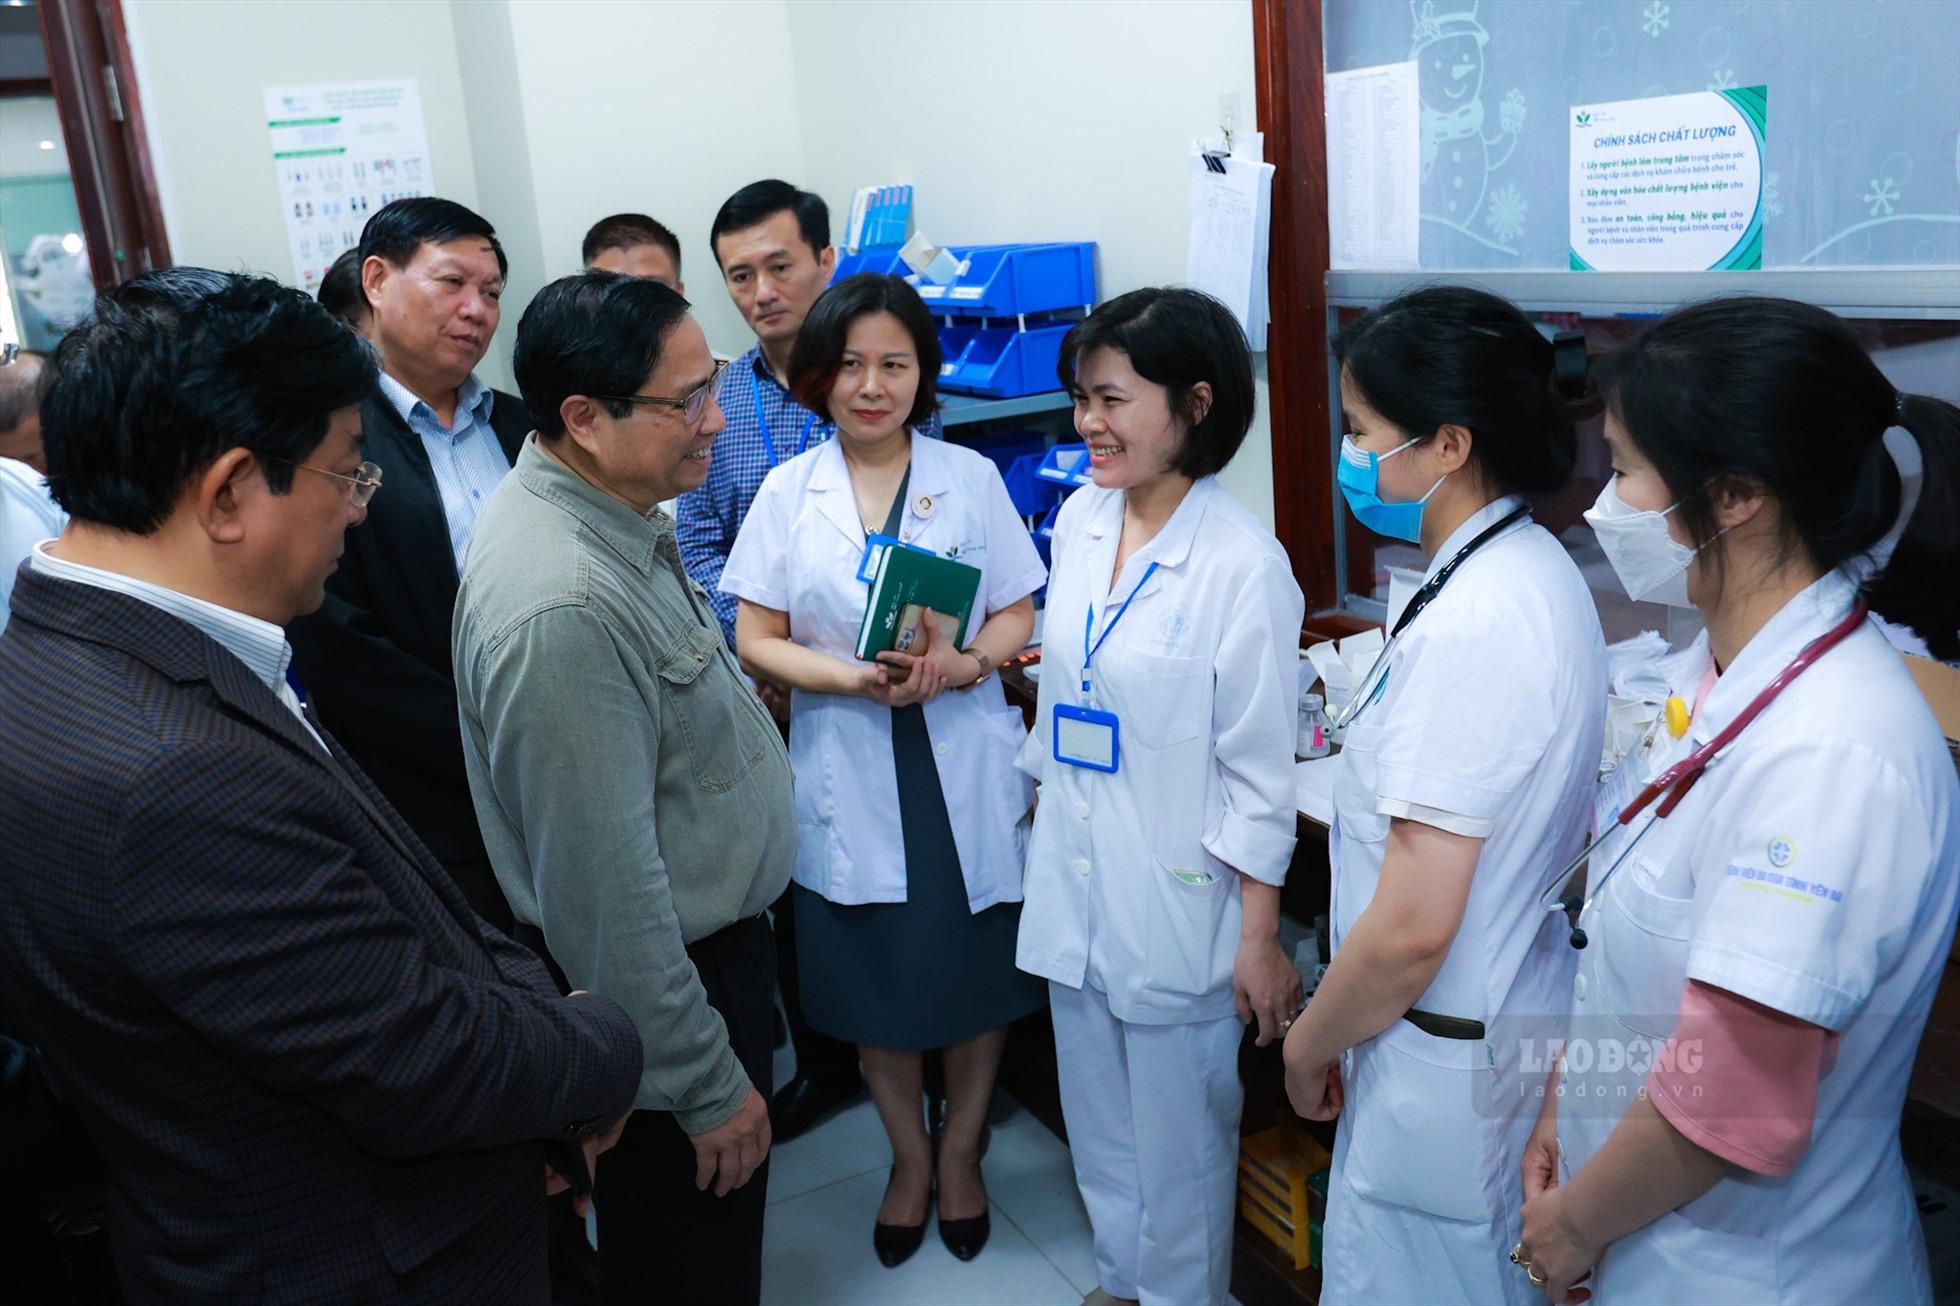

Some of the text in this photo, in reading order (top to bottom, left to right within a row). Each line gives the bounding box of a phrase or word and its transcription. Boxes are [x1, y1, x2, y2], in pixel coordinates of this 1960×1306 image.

[1594, 125, 1736, 148] CHÍNH SÁCH CHẤT LƯỢNG
[1599, 159, 1619, 170] người
[1620, 157, 1637, 168] bệnh
[1639, 156, 1652, 166] làm
[1691, 154, 1710, 162] trong
[1692, 165, 1710, 174] bệnh
[1711, 164, 1724, 172] cho
[1600, 187, 1617, 197] dựng
[1647, 183, 1663, 193] chất
[1665, 182, 1688, 193] lượng
[1690, 181, 1709, 192] bệnh
[1711, 181, 1729, 191] viện
[1730, 181, 1744, 189] cho
[1647, 212, 1663, 223] công
[1690, 211, 1708, 221] hiệu
[1730, 210, 1744, 218] cho
[1692, 223, 1710, 231] trình
[1730, 221, 1744, 231] cấp
